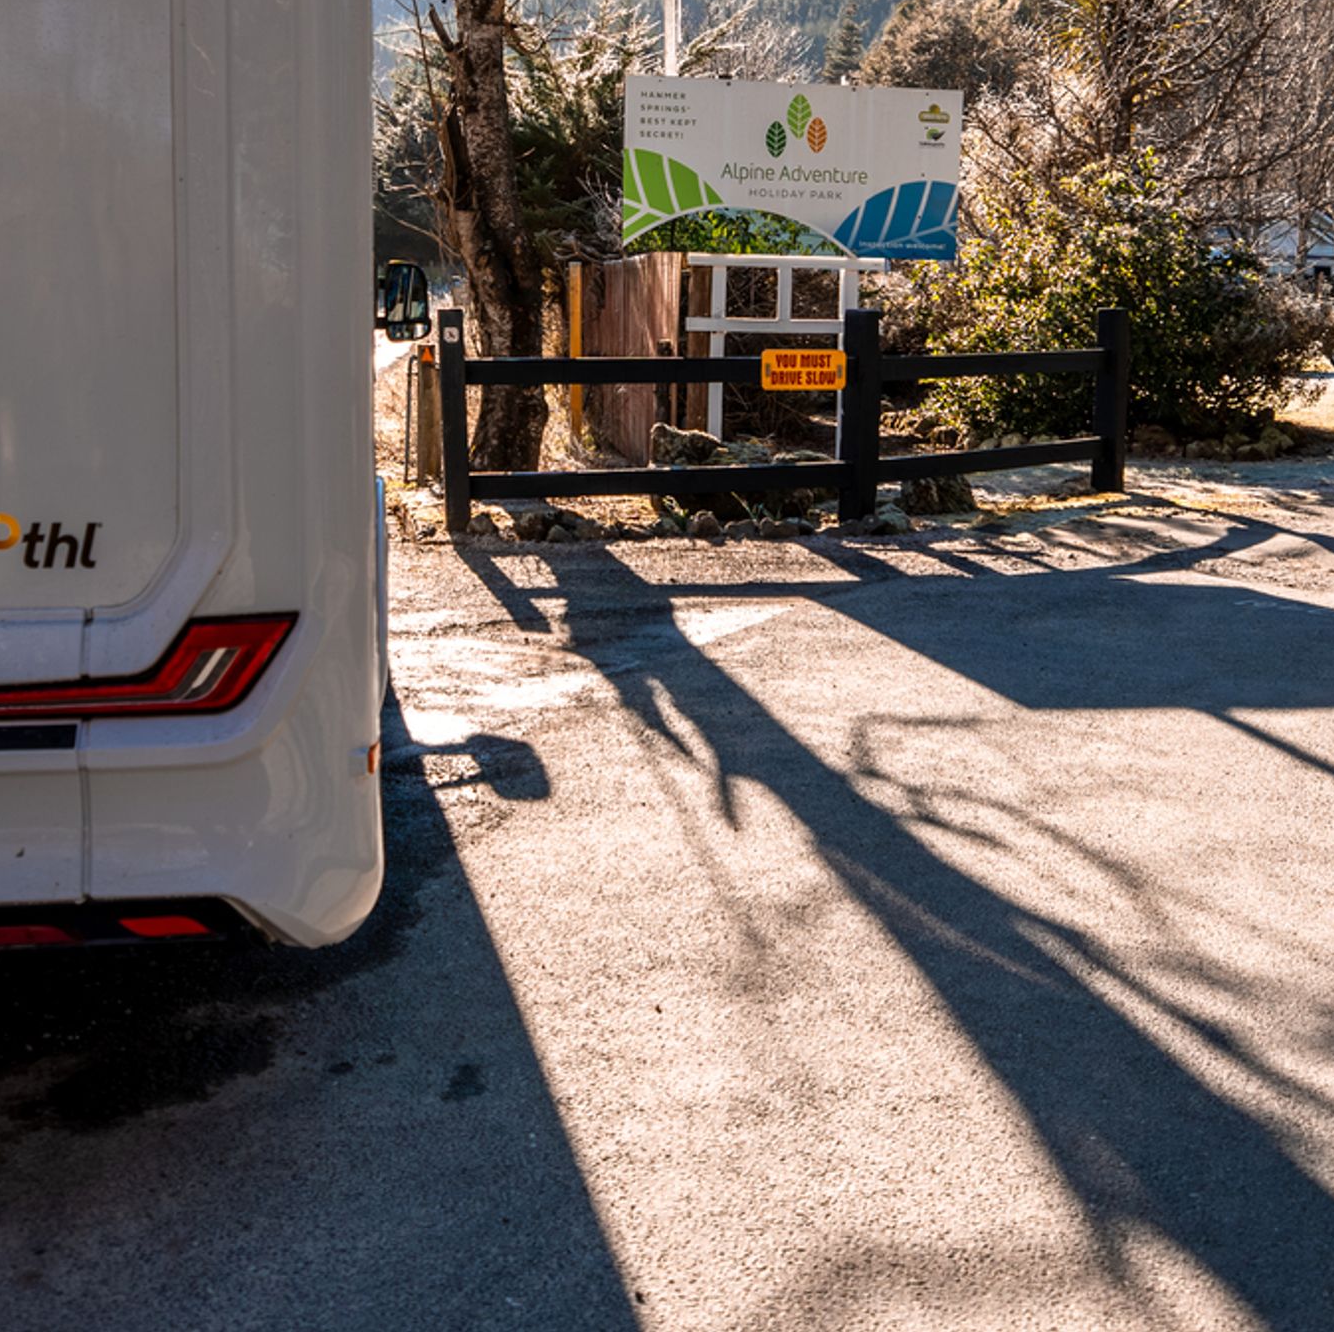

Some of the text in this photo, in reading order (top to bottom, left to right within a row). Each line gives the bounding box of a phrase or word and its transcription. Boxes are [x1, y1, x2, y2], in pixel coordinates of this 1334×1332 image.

[640, 91, 686, 100] HANMER
[640, 117, 696, 126] BEST KEPT
[720, 162, 869, 185] Alpine Adventure
[748, 188, 843, 200] HOLIDAY PARK
[775, 354, 832, 368] YOU MUST
[771, 371, 837, 385] DRIVE SLOW
